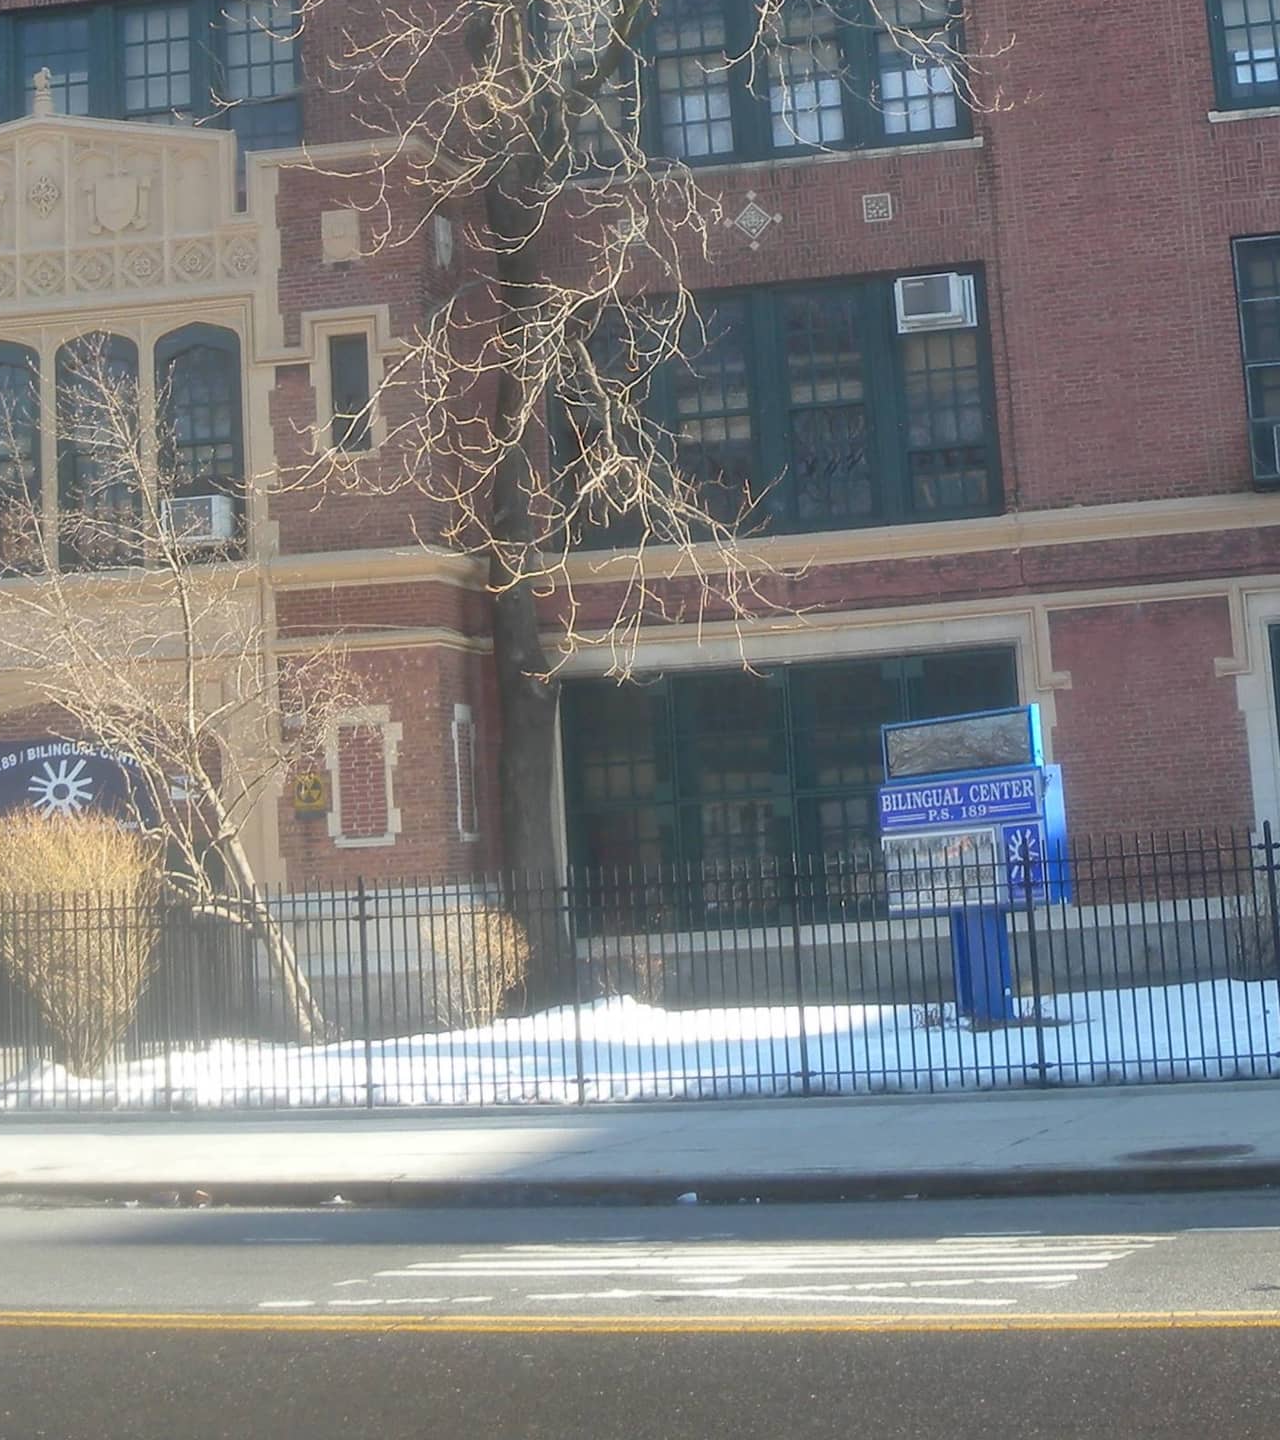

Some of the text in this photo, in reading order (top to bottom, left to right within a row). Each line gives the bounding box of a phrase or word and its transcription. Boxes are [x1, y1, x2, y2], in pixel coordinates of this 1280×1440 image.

[880, 778, 1034, 812] BILINGUAL CENTER
[928, 804, 987, 822] P.S. 189
